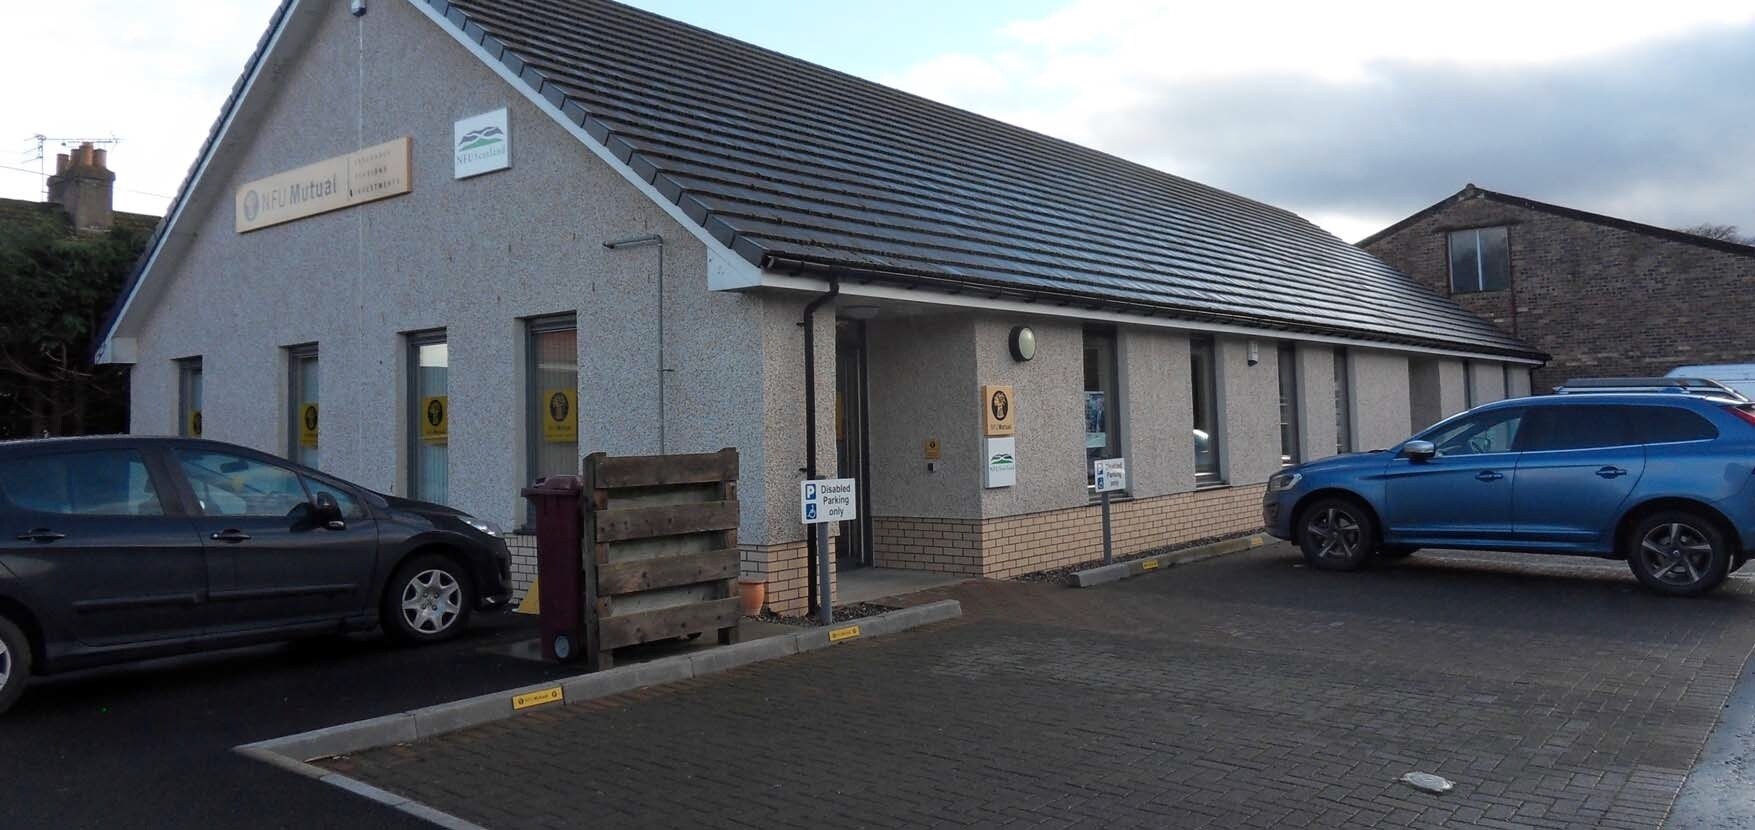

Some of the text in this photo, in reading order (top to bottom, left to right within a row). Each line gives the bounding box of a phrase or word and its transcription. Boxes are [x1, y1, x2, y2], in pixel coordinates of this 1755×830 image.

[261, 173, 337, 213] NFU Mutual
[821, 484, 850, 494] Disabled
[823, 496, 849, 505] Parking
[829, 507, 844, 517] only
